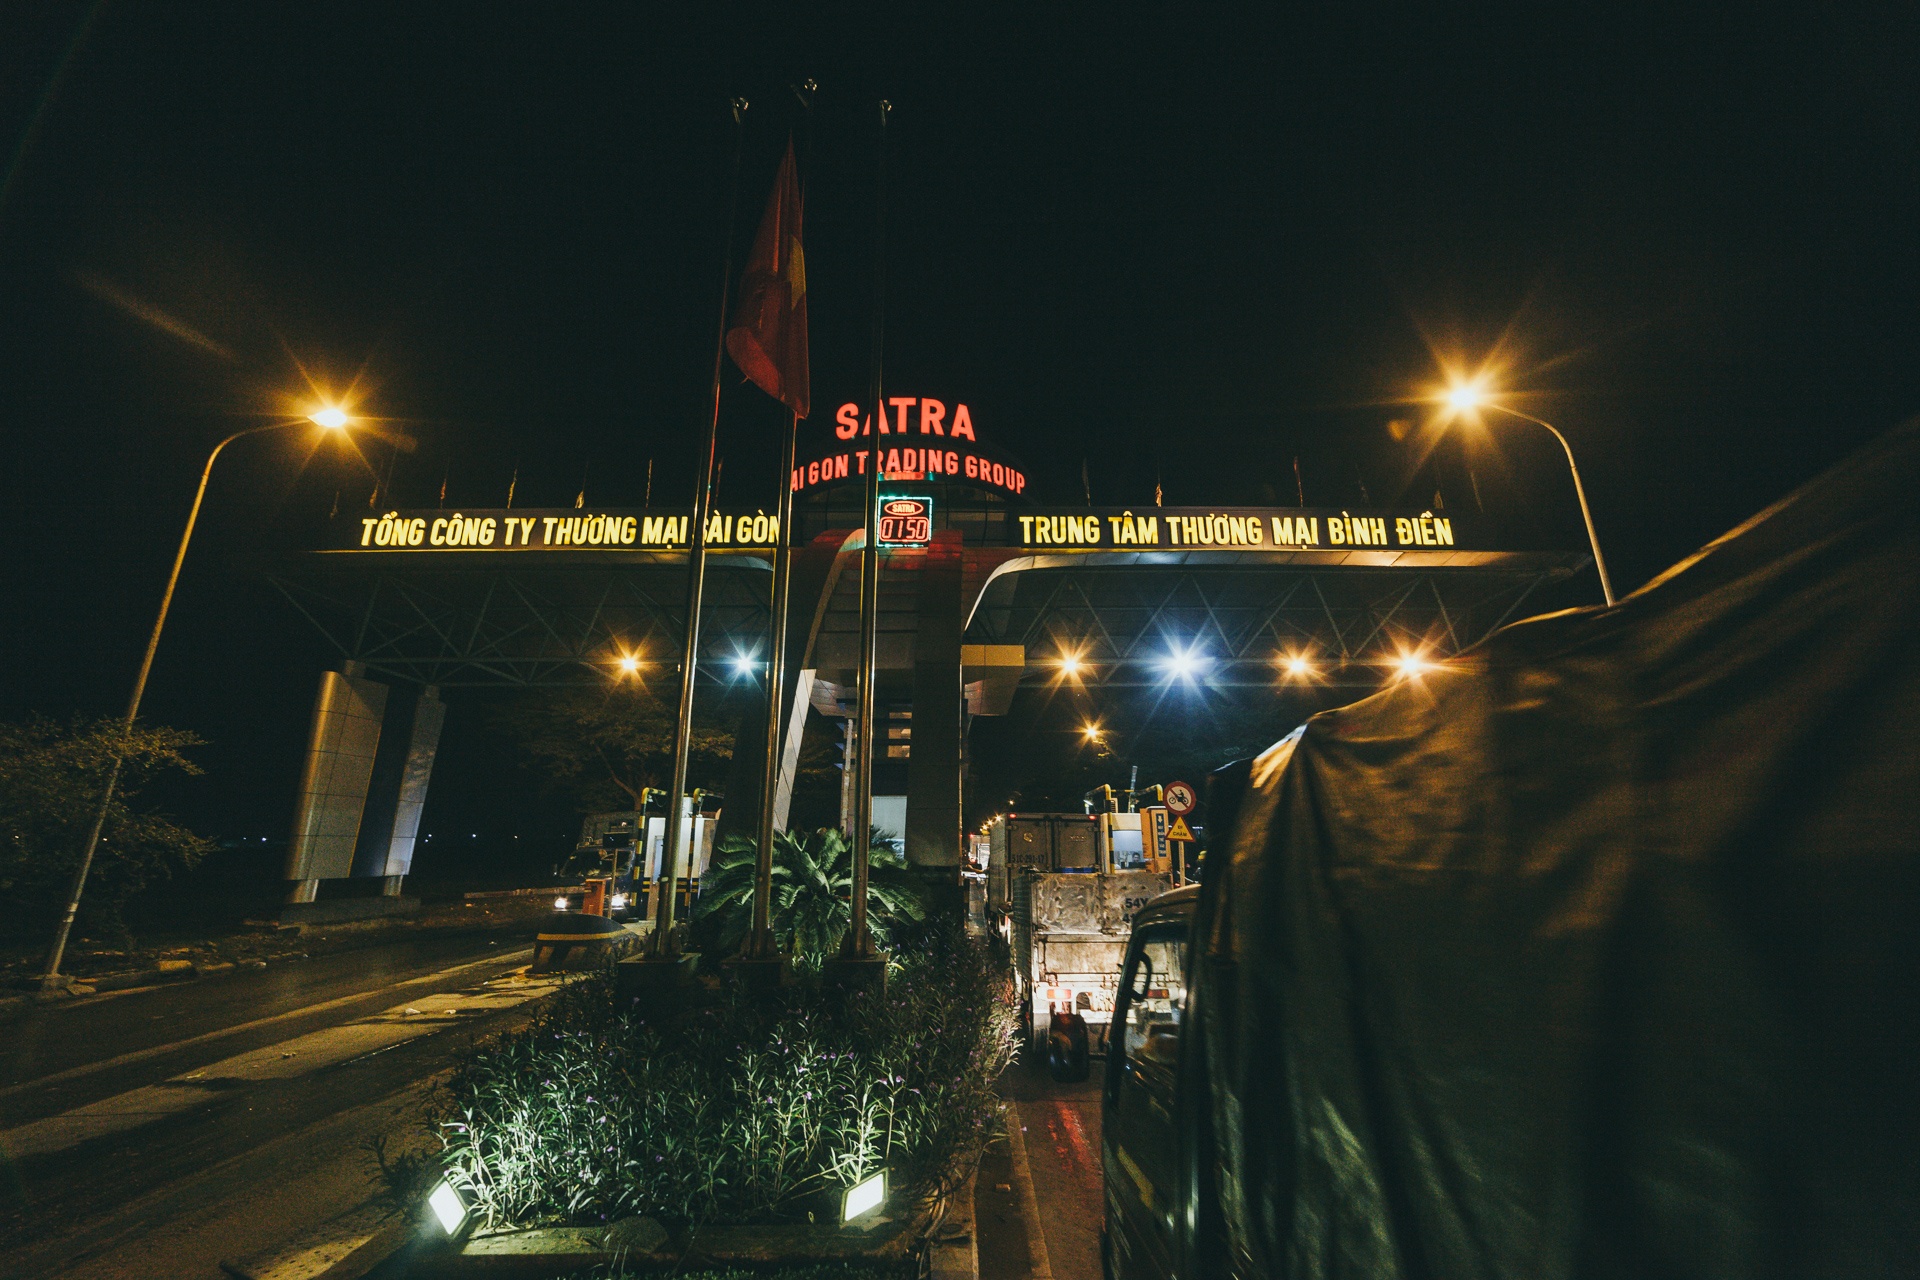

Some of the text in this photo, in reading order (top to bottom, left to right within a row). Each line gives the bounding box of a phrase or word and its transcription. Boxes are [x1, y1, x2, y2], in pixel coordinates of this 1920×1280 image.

[836, 397, 976, 442] SATRA
[790, 465, 805, 492] AI
[964, 455, 1026, 495] GROUP
[891, 504, 916, 513] SATRA
[361, 511, 426, 547] TỔNG
[430, 513, 497, 546] CÔNG
[504, 518, 537, 545] TY
[543, 514, 637, 545] THƯƠNG
[642, 516, 689, 550] MẠI
[736, 508, 780, 545] GÒN
[1019, 511, 1454, 550] TRUNG TÂM THƯƠNG MẠI BÌNH ĐIỀN
